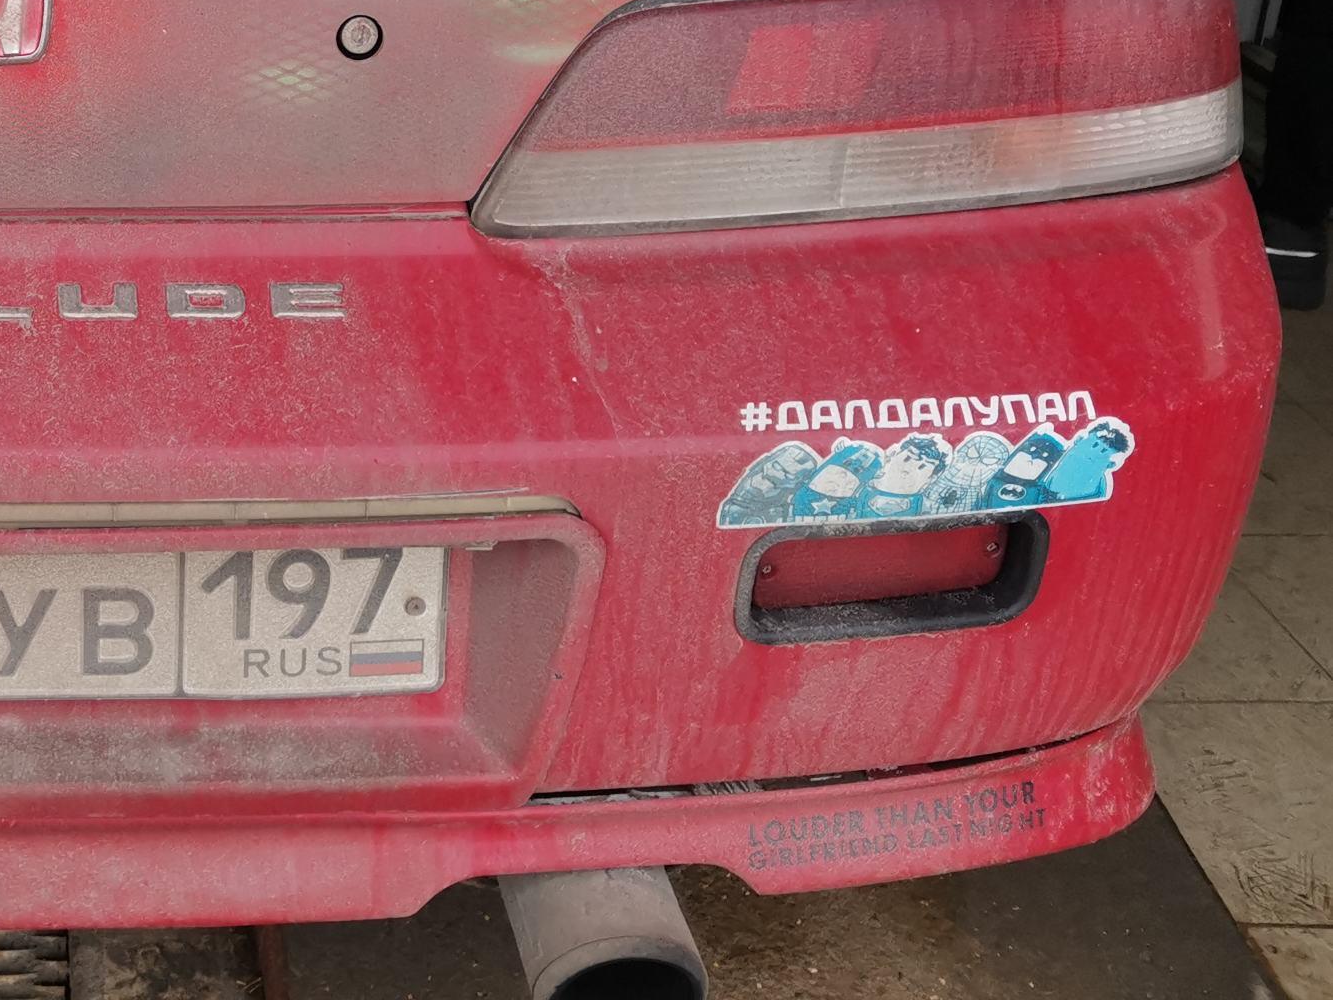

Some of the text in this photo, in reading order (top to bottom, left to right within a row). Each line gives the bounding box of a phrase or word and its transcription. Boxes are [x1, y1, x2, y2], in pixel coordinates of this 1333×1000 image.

[201, 547, 404, 640] 197
[242, 646, 343, 679] RUS
[748, 781, 1035, 847] LOUDER THAN YOUR
[906, 823, 963, 849] LAST
